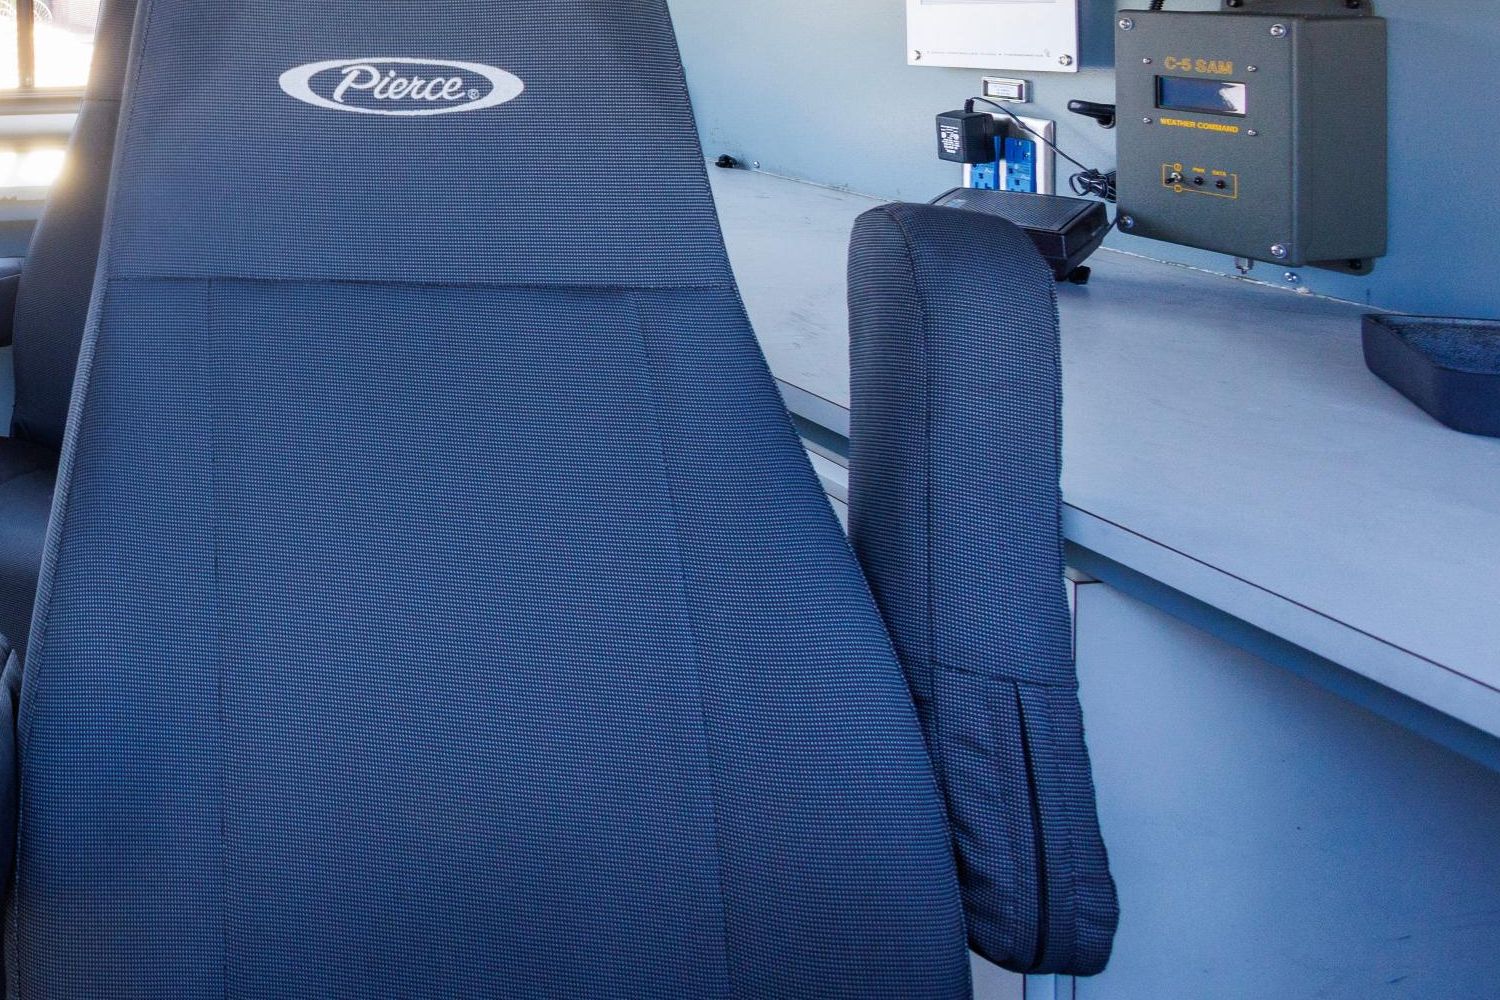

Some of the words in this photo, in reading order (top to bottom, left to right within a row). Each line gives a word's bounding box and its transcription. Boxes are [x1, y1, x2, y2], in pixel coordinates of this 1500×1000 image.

[1195, 58, 1233, 75] SAM
[333, 64, 466, 103] Pierce
[1160, 117, 1196, 128] WEATHER
[1197, 121, 1239, 133] COMMAND
